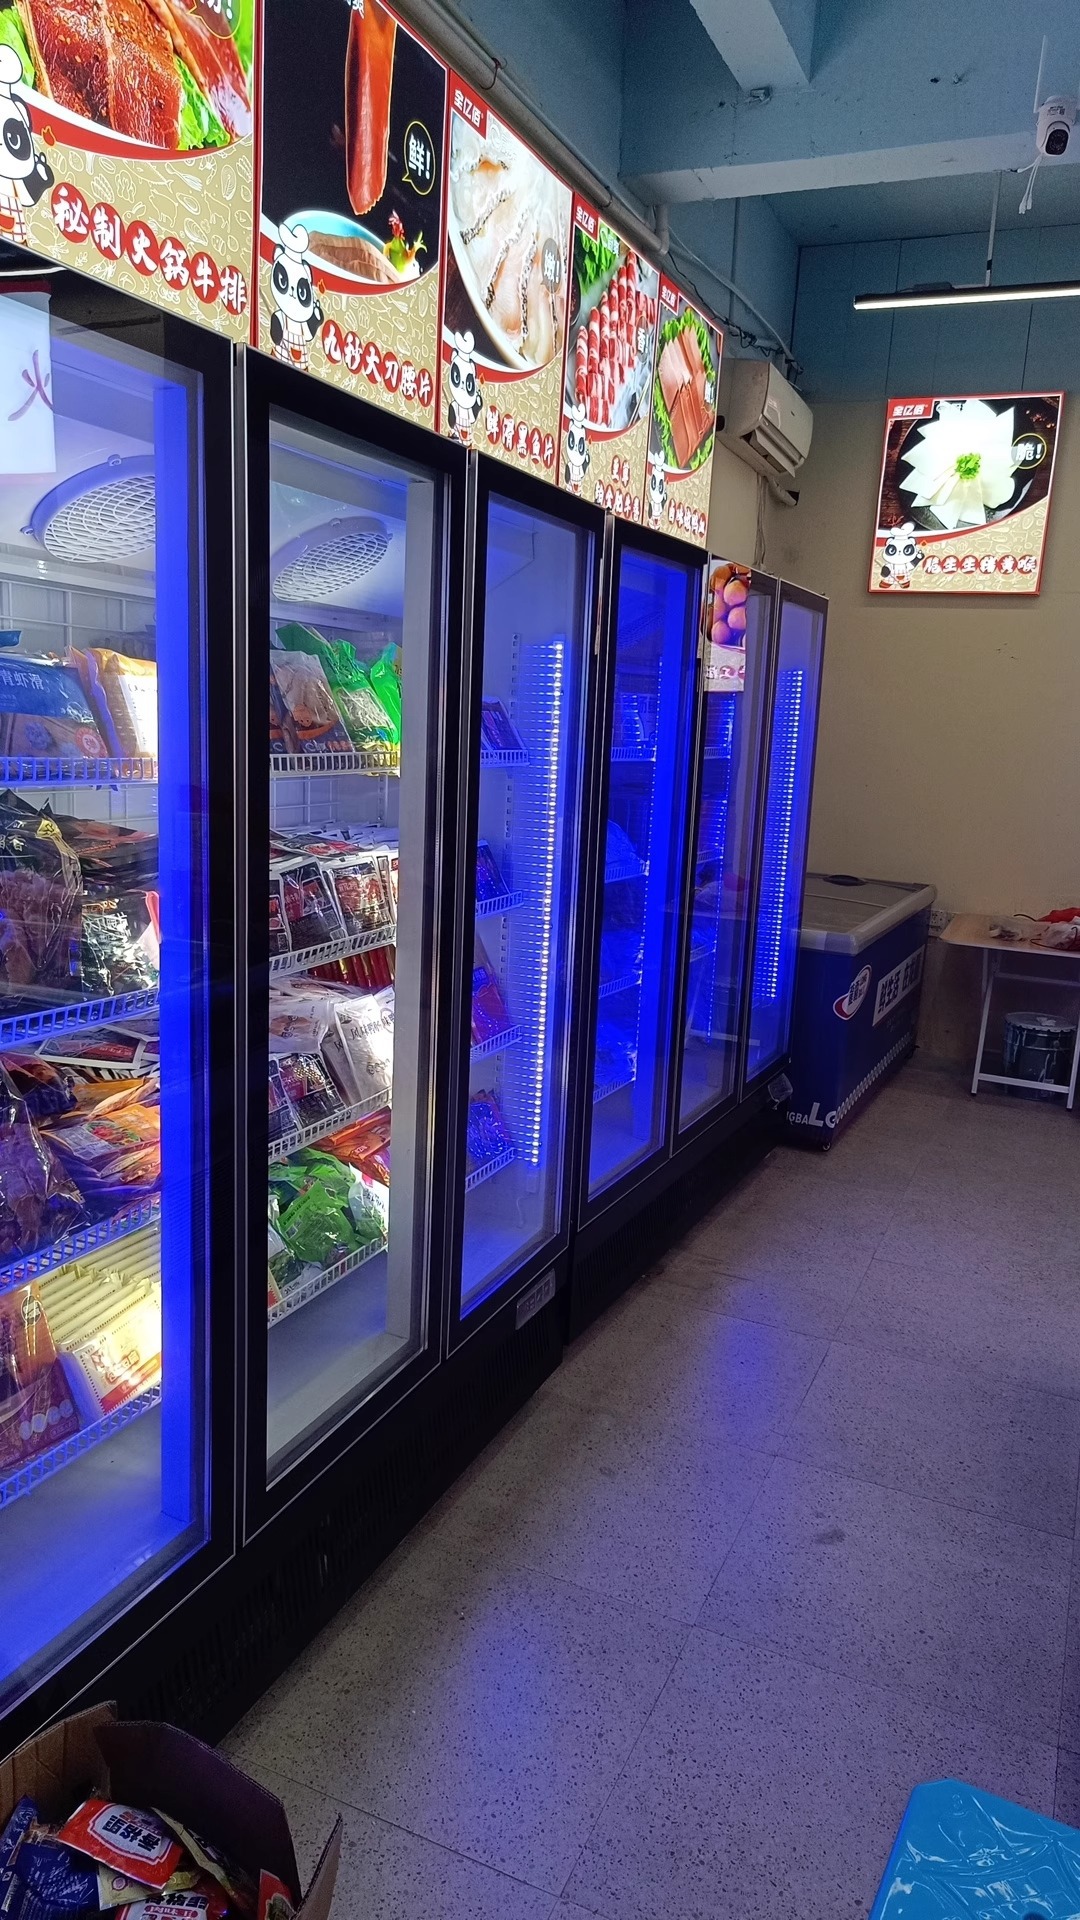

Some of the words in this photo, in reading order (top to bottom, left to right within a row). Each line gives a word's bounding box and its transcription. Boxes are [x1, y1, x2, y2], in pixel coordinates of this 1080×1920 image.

[408, 133, 432, 180] 鲜!
[54, 186, 247, 315] 秘制火锅牛排
[7, 349, 54, 421] 火
[322, 322, 433, 406] 九秒大刀腰片
[102, 1815, 161, 1852] 香格里
